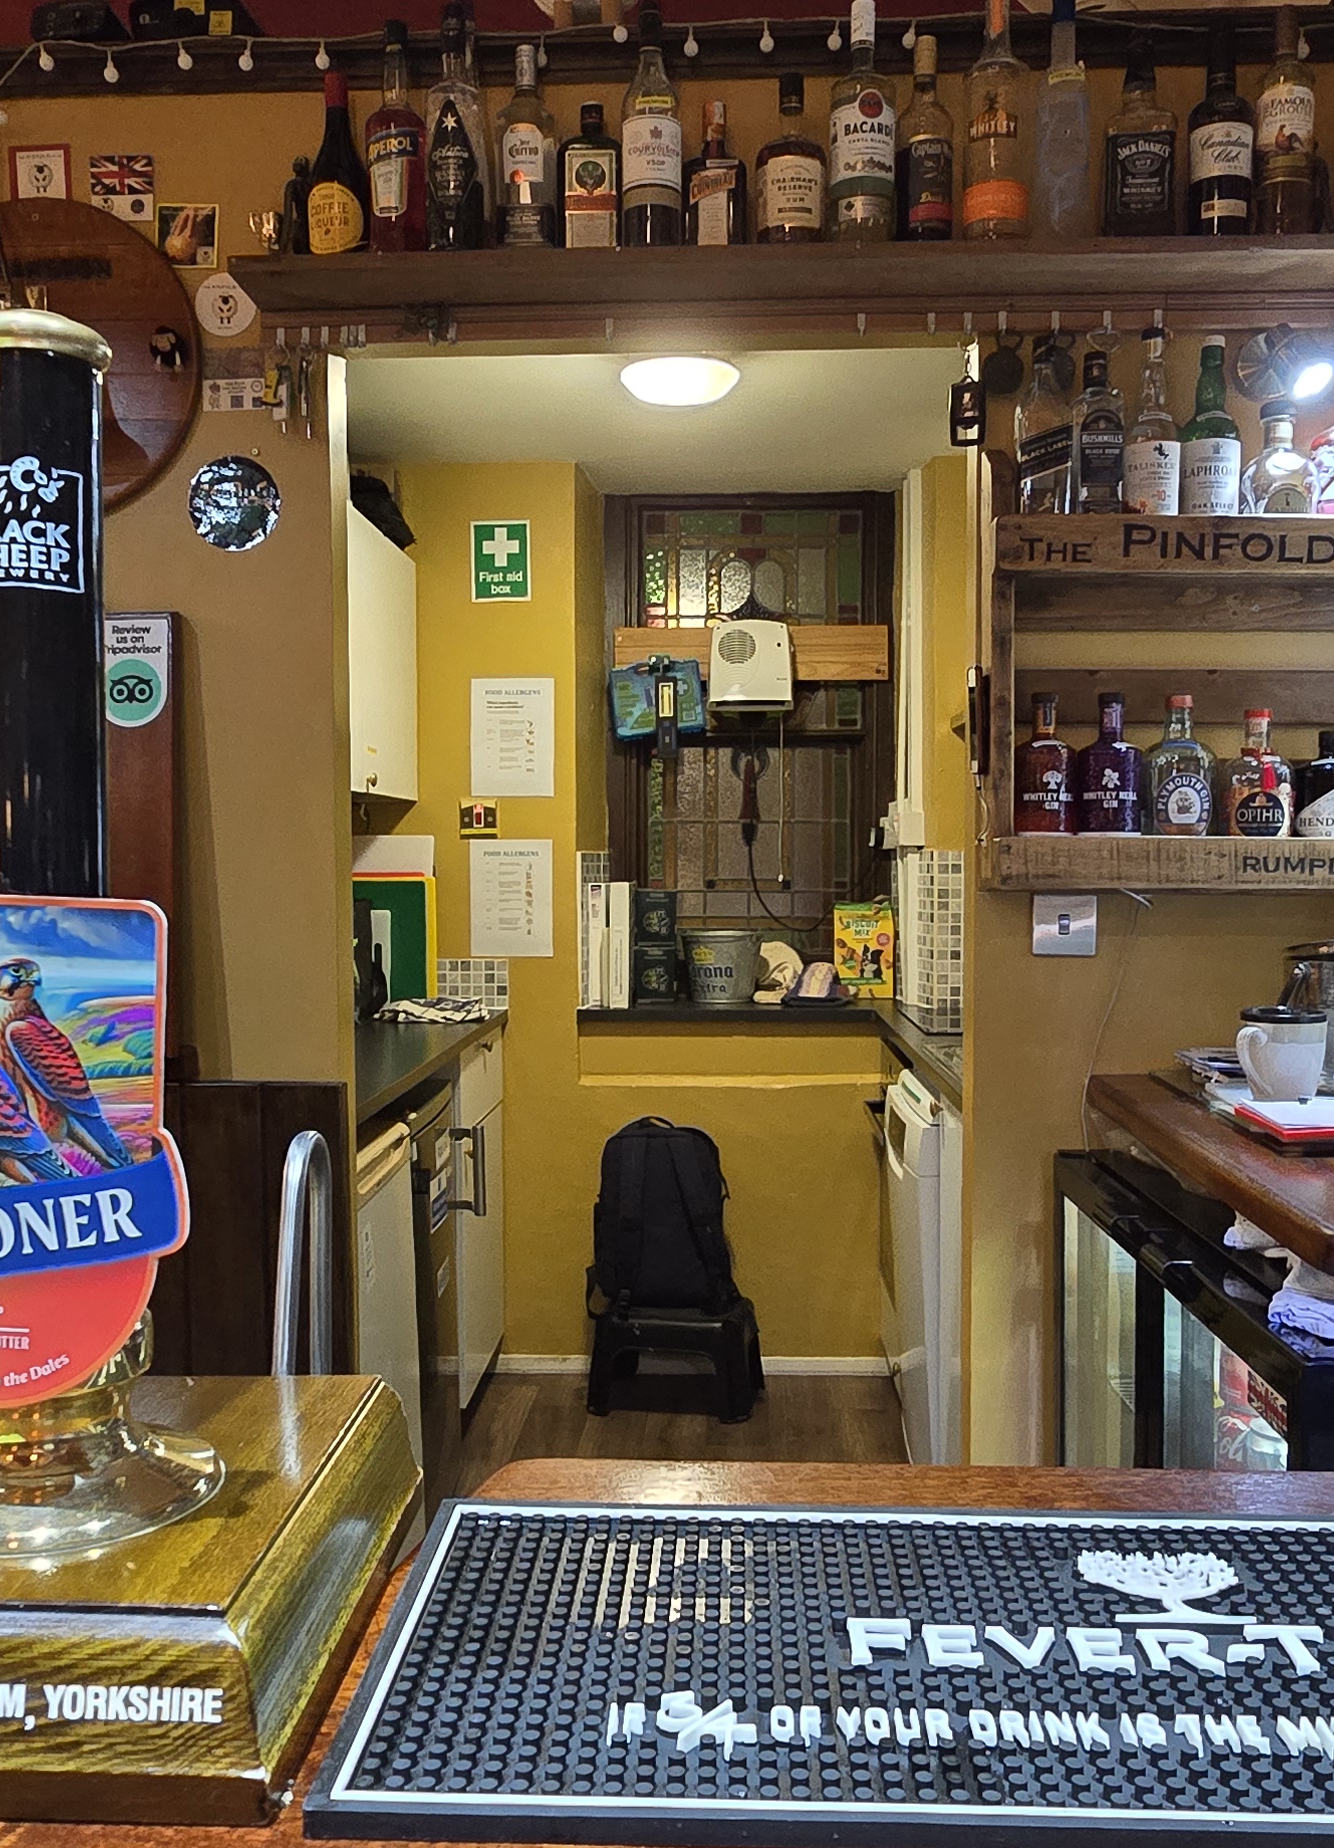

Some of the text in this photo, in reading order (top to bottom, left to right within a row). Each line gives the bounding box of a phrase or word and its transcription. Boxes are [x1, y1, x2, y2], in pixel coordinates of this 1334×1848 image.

[1199, 133, 1250, 151] Canadian
[368, 136, 413, 162] APEROL
[1117, 143, 1137, 160] JACK
[1212, 148, 1242, 164] Club
[311, 202, 349, 215] COFFEE
[1082, 434, 1123, 444] BUSHMILLS
[1020, 537, 1093, 563] THE
[479, 570, 523, 582] First aid
[491, 584, 512, 594] box
[112, 625, 151, 636] Review
[116, 635, 144, 645] us on
[106, 644, 163, 657] ripadvisor
[1023, 792, 1057, 801] WHITLEY
[1083, 791, 1117, 801] WHITLEY
[1157, 776, 1211, 810] PLYMOUTH GIN
[1045, 801, 1059, 810] GIN
[1103, 801, 1118, 809] GIN
[1237, 808, 1284, 822] OPIHR
[854, 929, 871, 937] MIX
[4, 1370, 28, 1387] the
[30, 1352, 71, 1383] Dales
[43, 1683, 222, 1725] YORKSHIRE
[606, 1702, 646, 1747] IF
[770, 1705, 821, 1748] OF
[836, 1706, 953, 1748] YOUR
[969, 1709, 1110, 1752] DRINK
[1120, 1711, 1166, 1753] IS
[1174, 1713, 1270, 1758] THE
